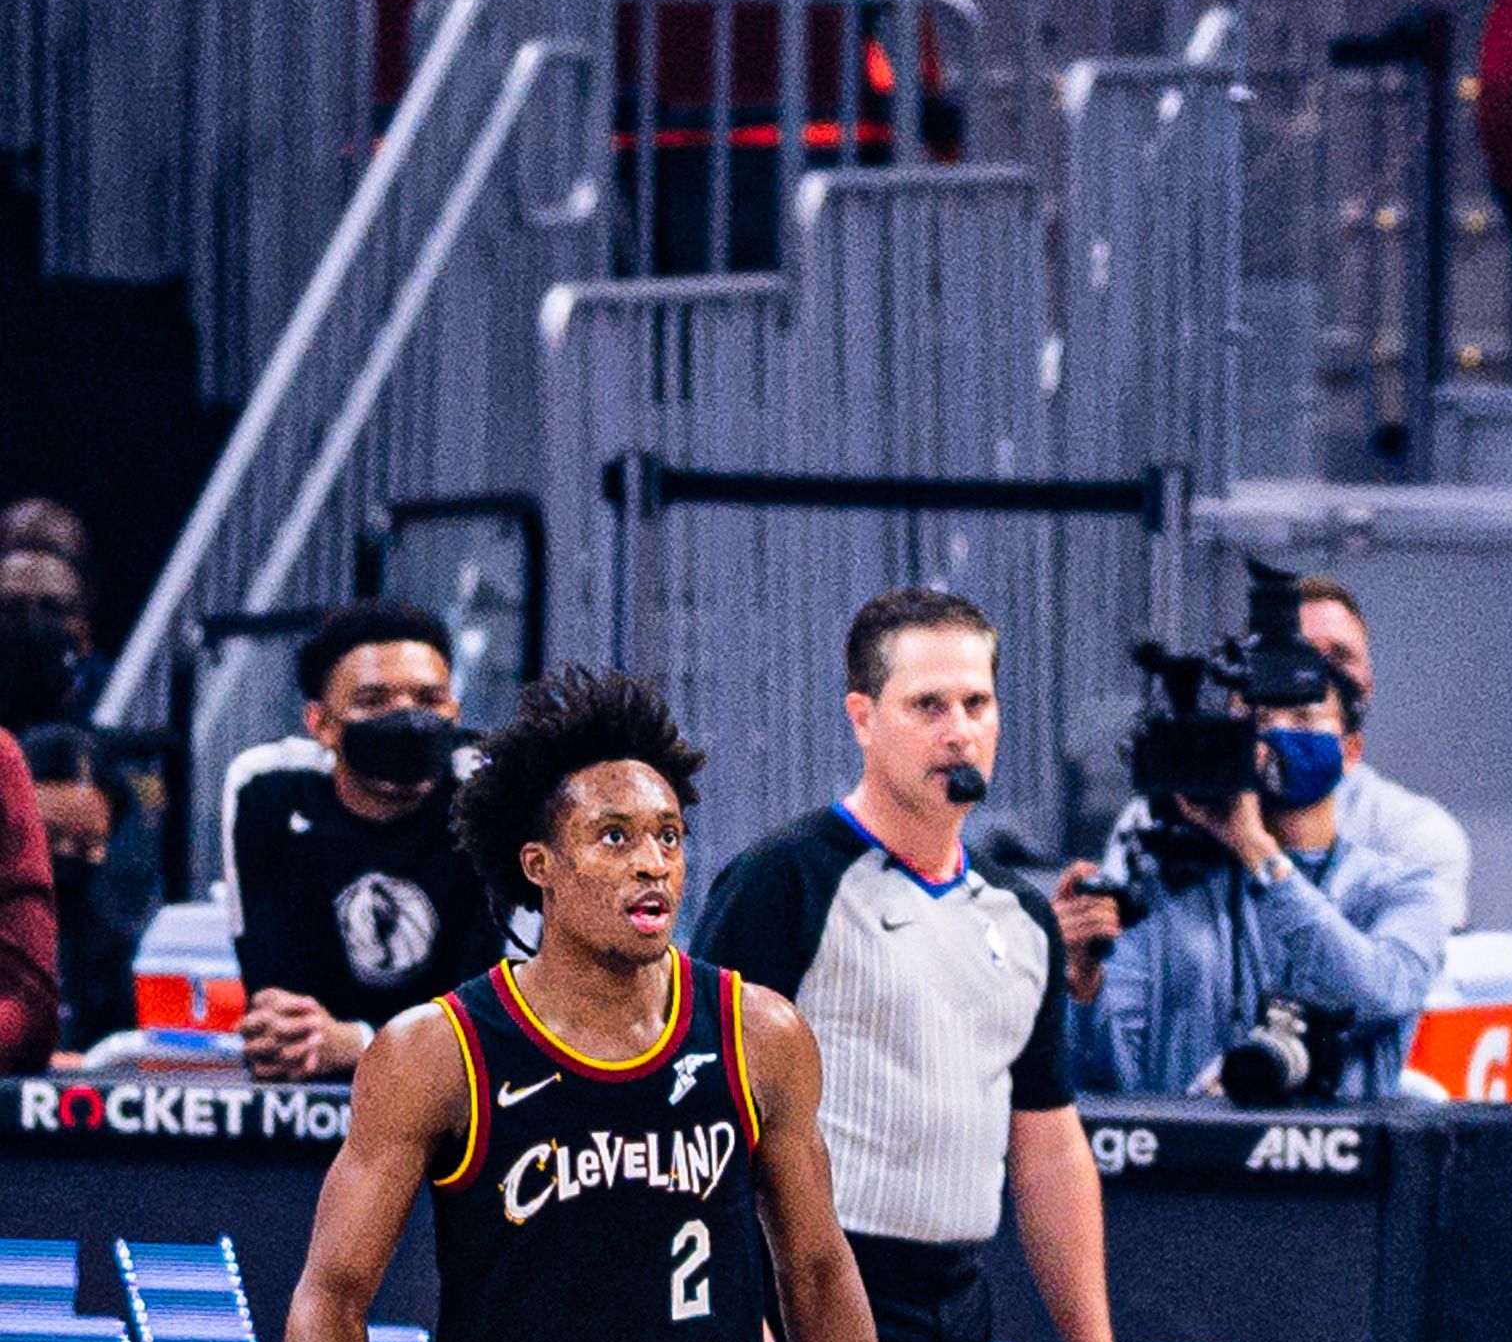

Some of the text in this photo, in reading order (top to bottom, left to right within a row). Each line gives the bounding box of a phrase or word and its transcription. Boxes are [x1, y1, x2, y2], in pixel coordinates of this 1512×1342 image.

[20, 1079, 252, 1136] ROCKET
[1245, 1126, 1360, 1173] ANC
[670, 1220, 712, 1321] 2
